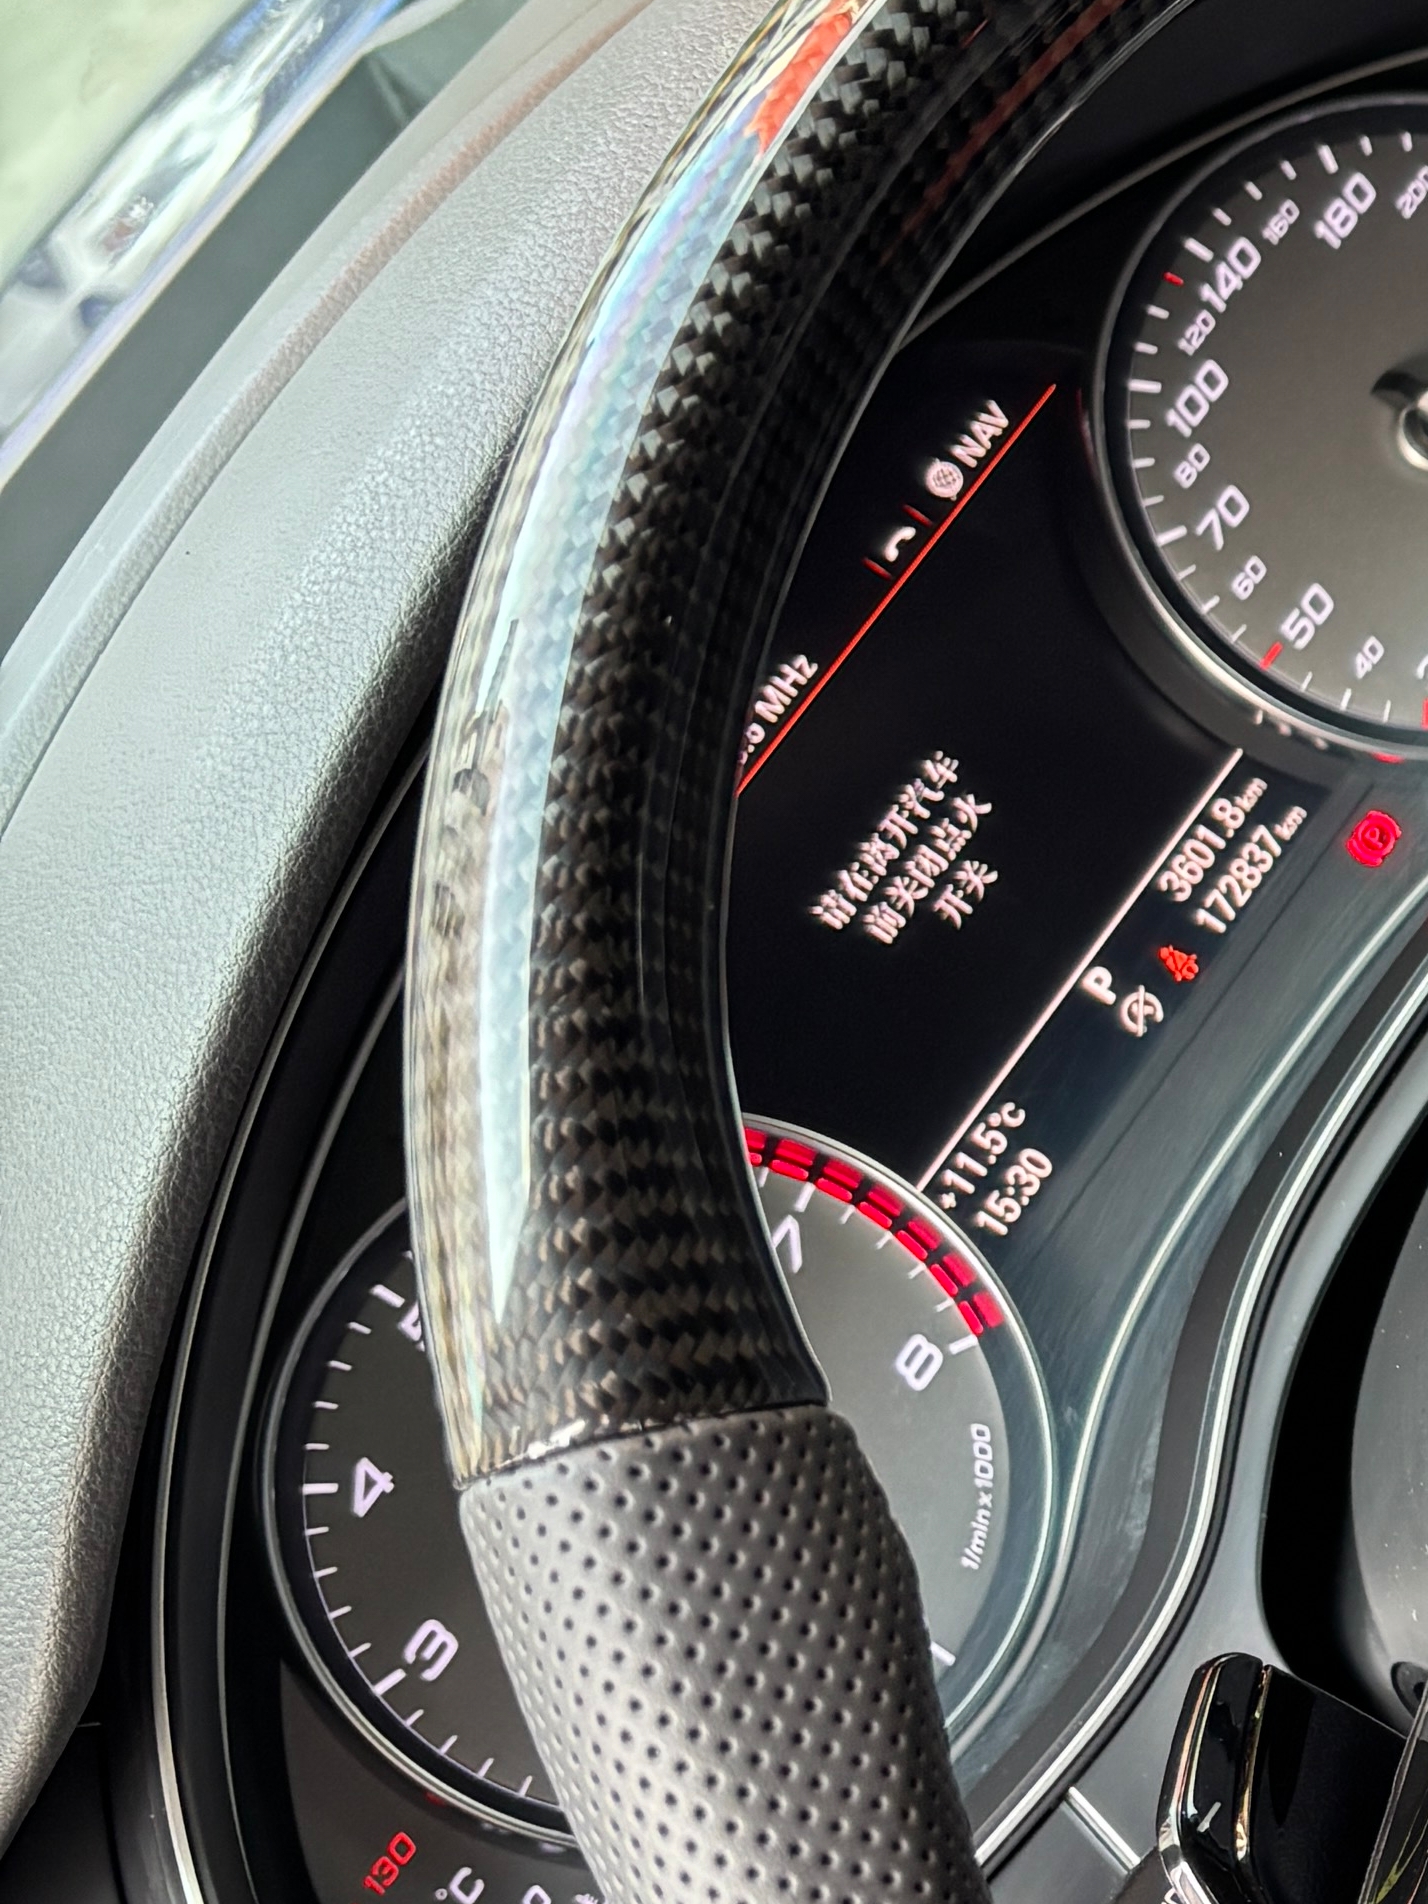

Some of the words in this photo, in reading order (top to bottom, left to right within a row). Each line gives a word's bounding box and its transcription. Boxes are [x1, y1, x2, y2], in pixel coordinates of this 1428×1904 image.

[1262, 200, 1299, 244] 160
[1315, 173, 1376, 249] 180
[1200, 237, 1261, 312] 140
[1178, 310, 1215, 355] 120
[1166, 360, 1228, 437] 100
[951, 400, 1008, 467] NAV
[1174, 444, 1210, 488] 80
[1196, 485, 1249, 550] 70
[1231, 556, 1266, 600] 60
[1280, 583, 1334, 649] 50
[755, 655, 818, 722] MHz
[1355, 636, 1384, 679] 40
[812, 751, 958, 929] 请在离开汽车
[864, 794, 992, 943] 前关闭点火
[934, 860, 998, 927] 开关
[1081, 966, 1116, 1004] P
[975, 1148, 1052, 1235] 15:30
[895, 1334, 943, 1391] 8
[352, 1459, 396, 1517] 4
[970, 1423, 993, 1499] 1000
[404, 1620, 458, 1681] 3
[364, 1833, 415, 1895] 130
